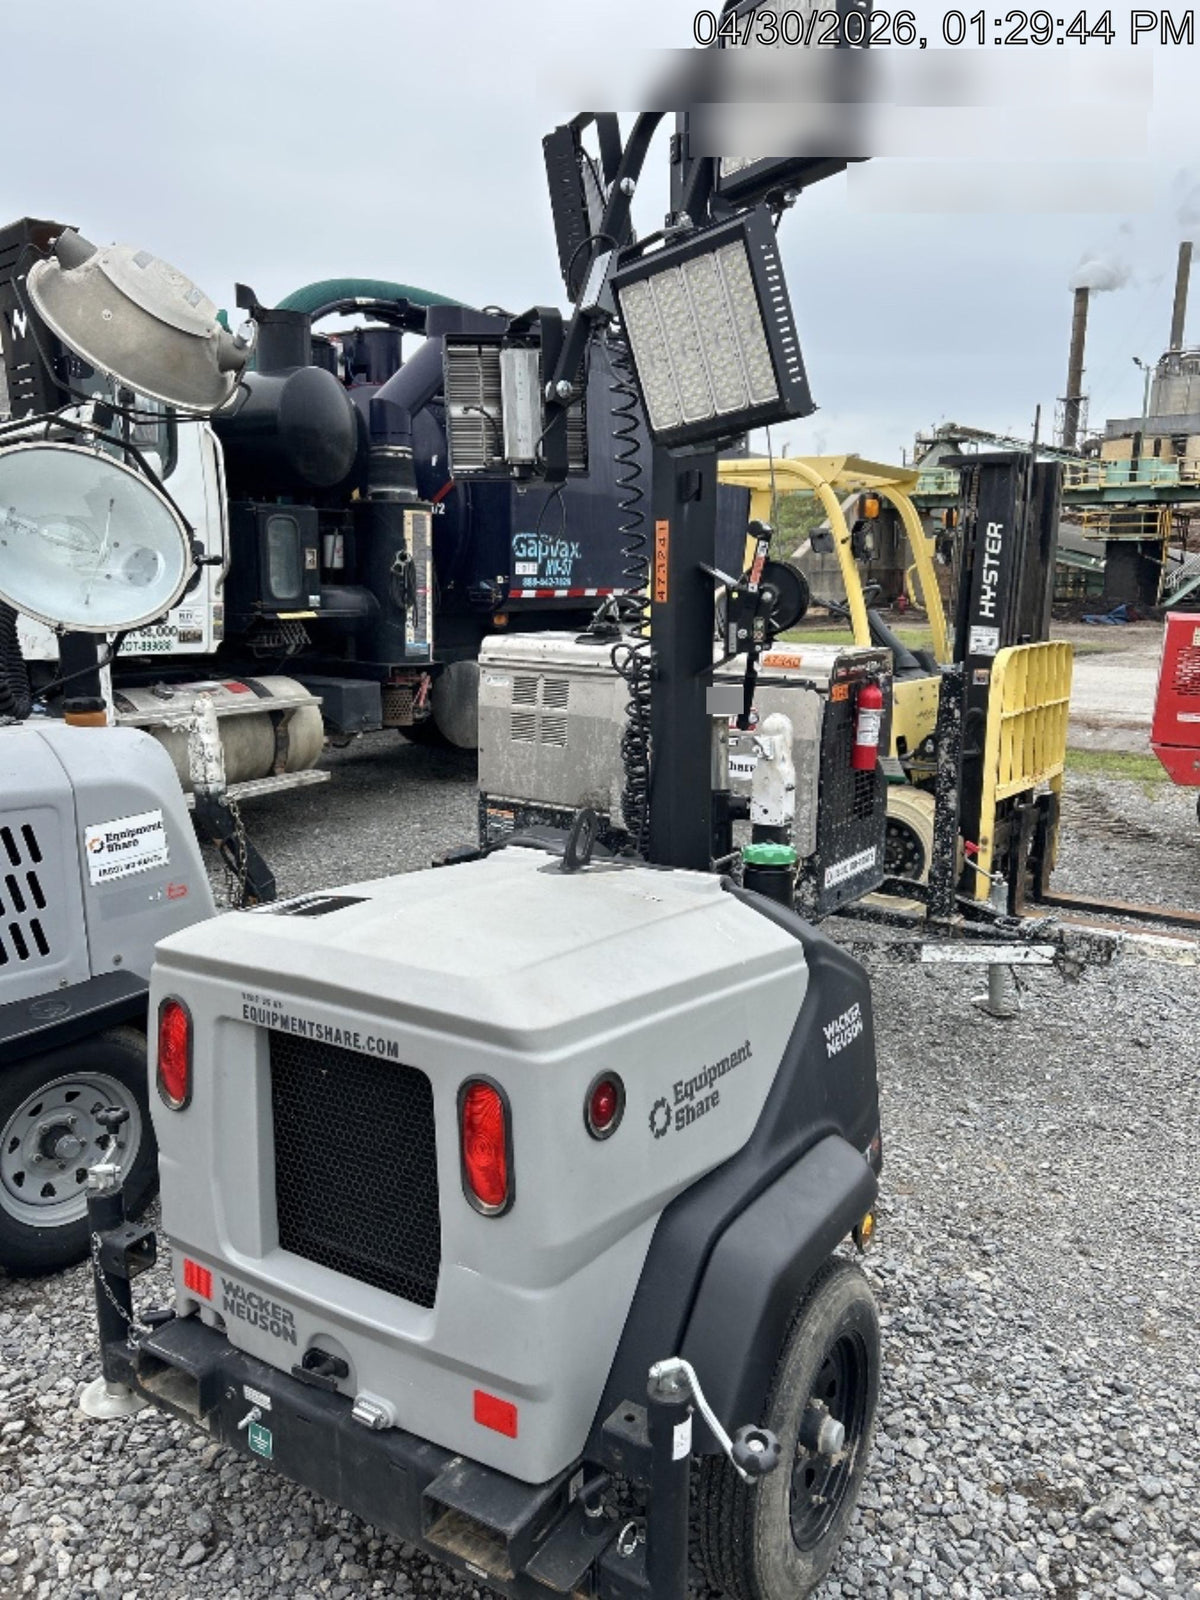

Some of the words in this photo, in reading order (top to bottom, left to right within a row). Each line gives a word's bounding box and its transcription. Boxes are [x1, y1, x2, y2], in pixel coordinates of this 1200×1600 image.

[979, 521, 1004, 618] HYSTER
[104, 820, 162, 843] Equipment
[106, 838, 139, 853] Share
[242, 1004, 399, 1058] EQUIPMENTSHARE.COM
[822, 1002, 862, 1040] WACKER
[825, 1016, 864, 1059] NEUSON
[672, 1039, 753, 1106] Equipment
[674, 1089, 720, 1132] Share
[221, 1276, 296, 1329] WACKER
[223, 1295, 298, 1347] NEUSON
